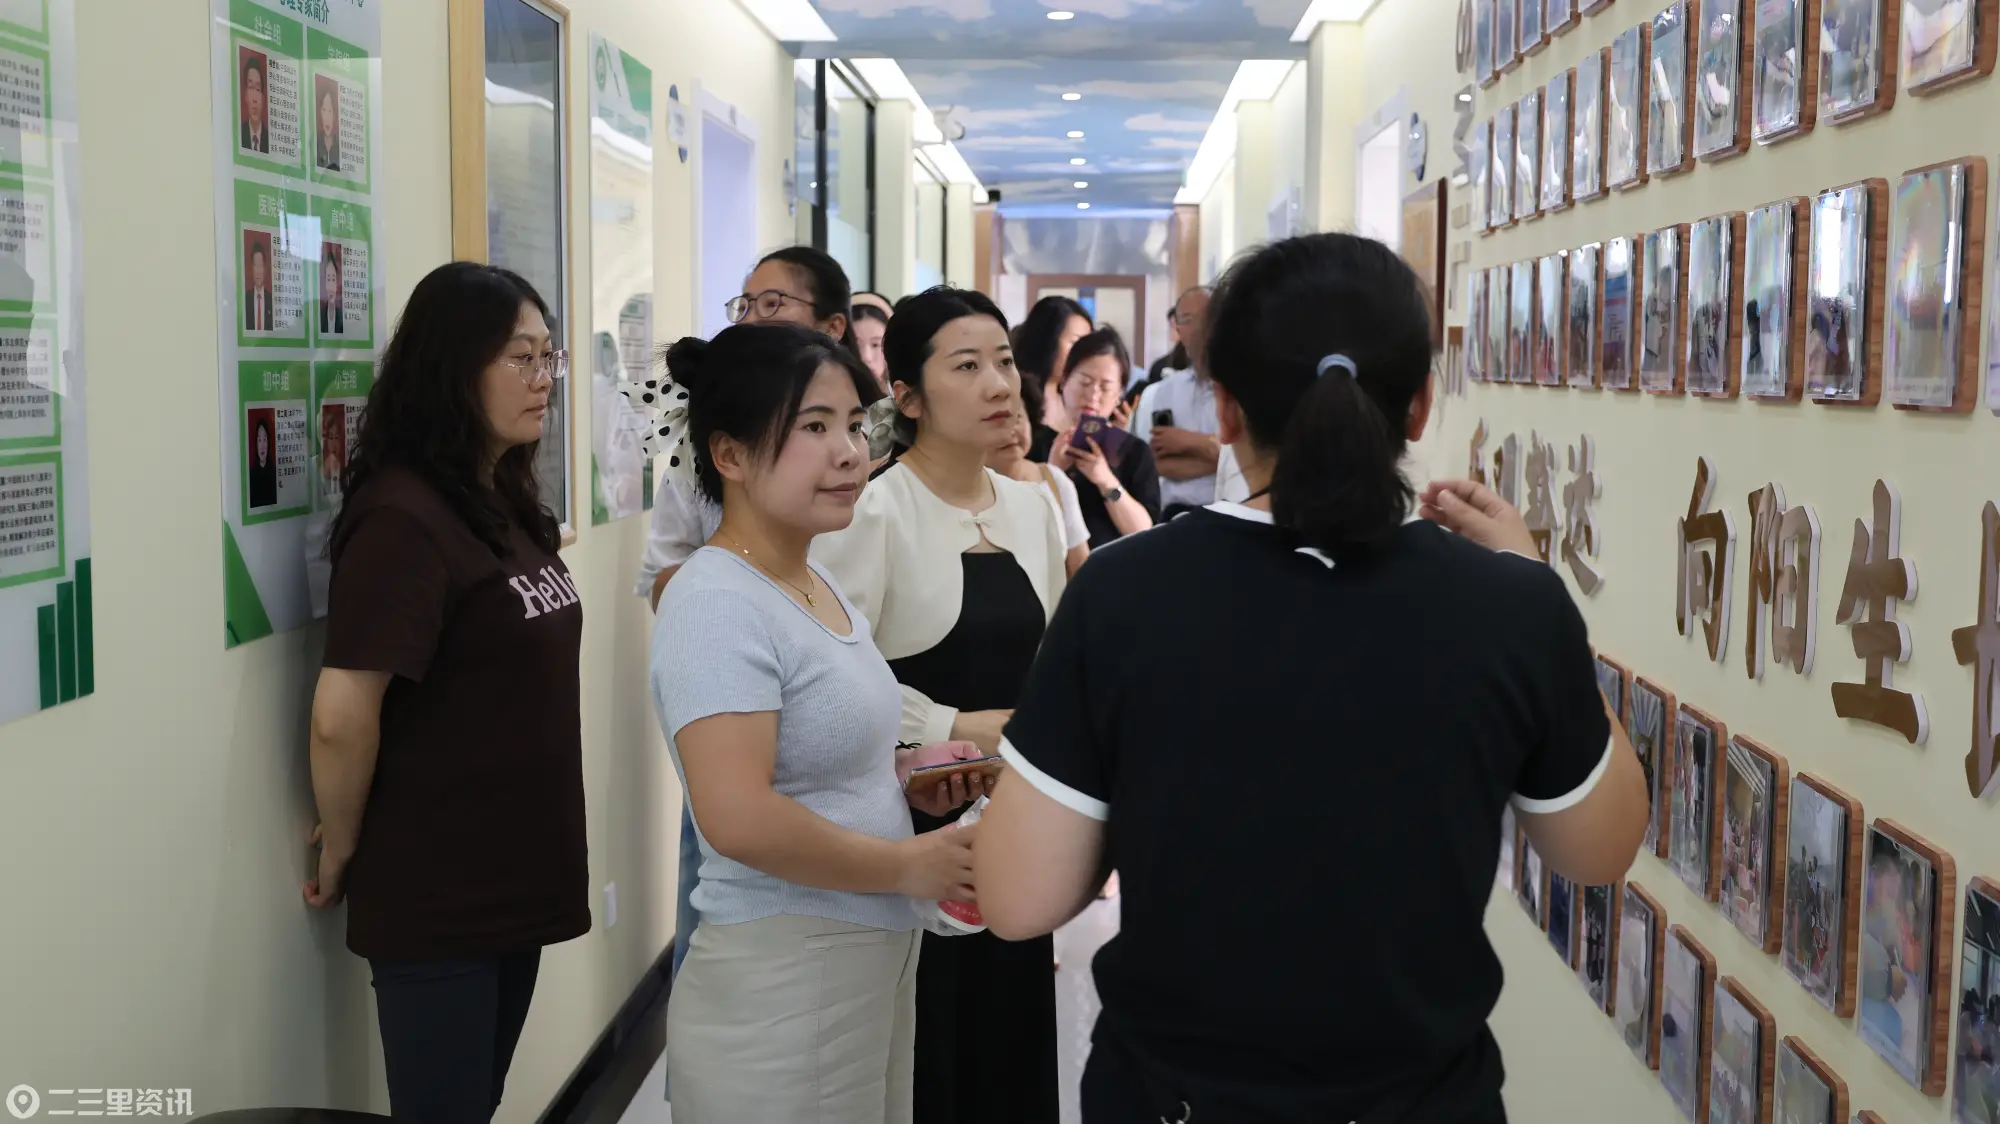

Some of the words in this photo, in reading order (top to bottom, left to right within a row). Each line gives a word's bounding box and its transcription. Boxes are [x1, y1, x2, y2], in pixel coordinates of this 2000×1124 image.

[281, 0, 329, 25] 专家简介
[254, 16, 282, 46] 社会组
[331, 207, 354, 232] 高中组
[262, 370, 290, 392] 初中组
[334, 369, 357, 390] 小学组
